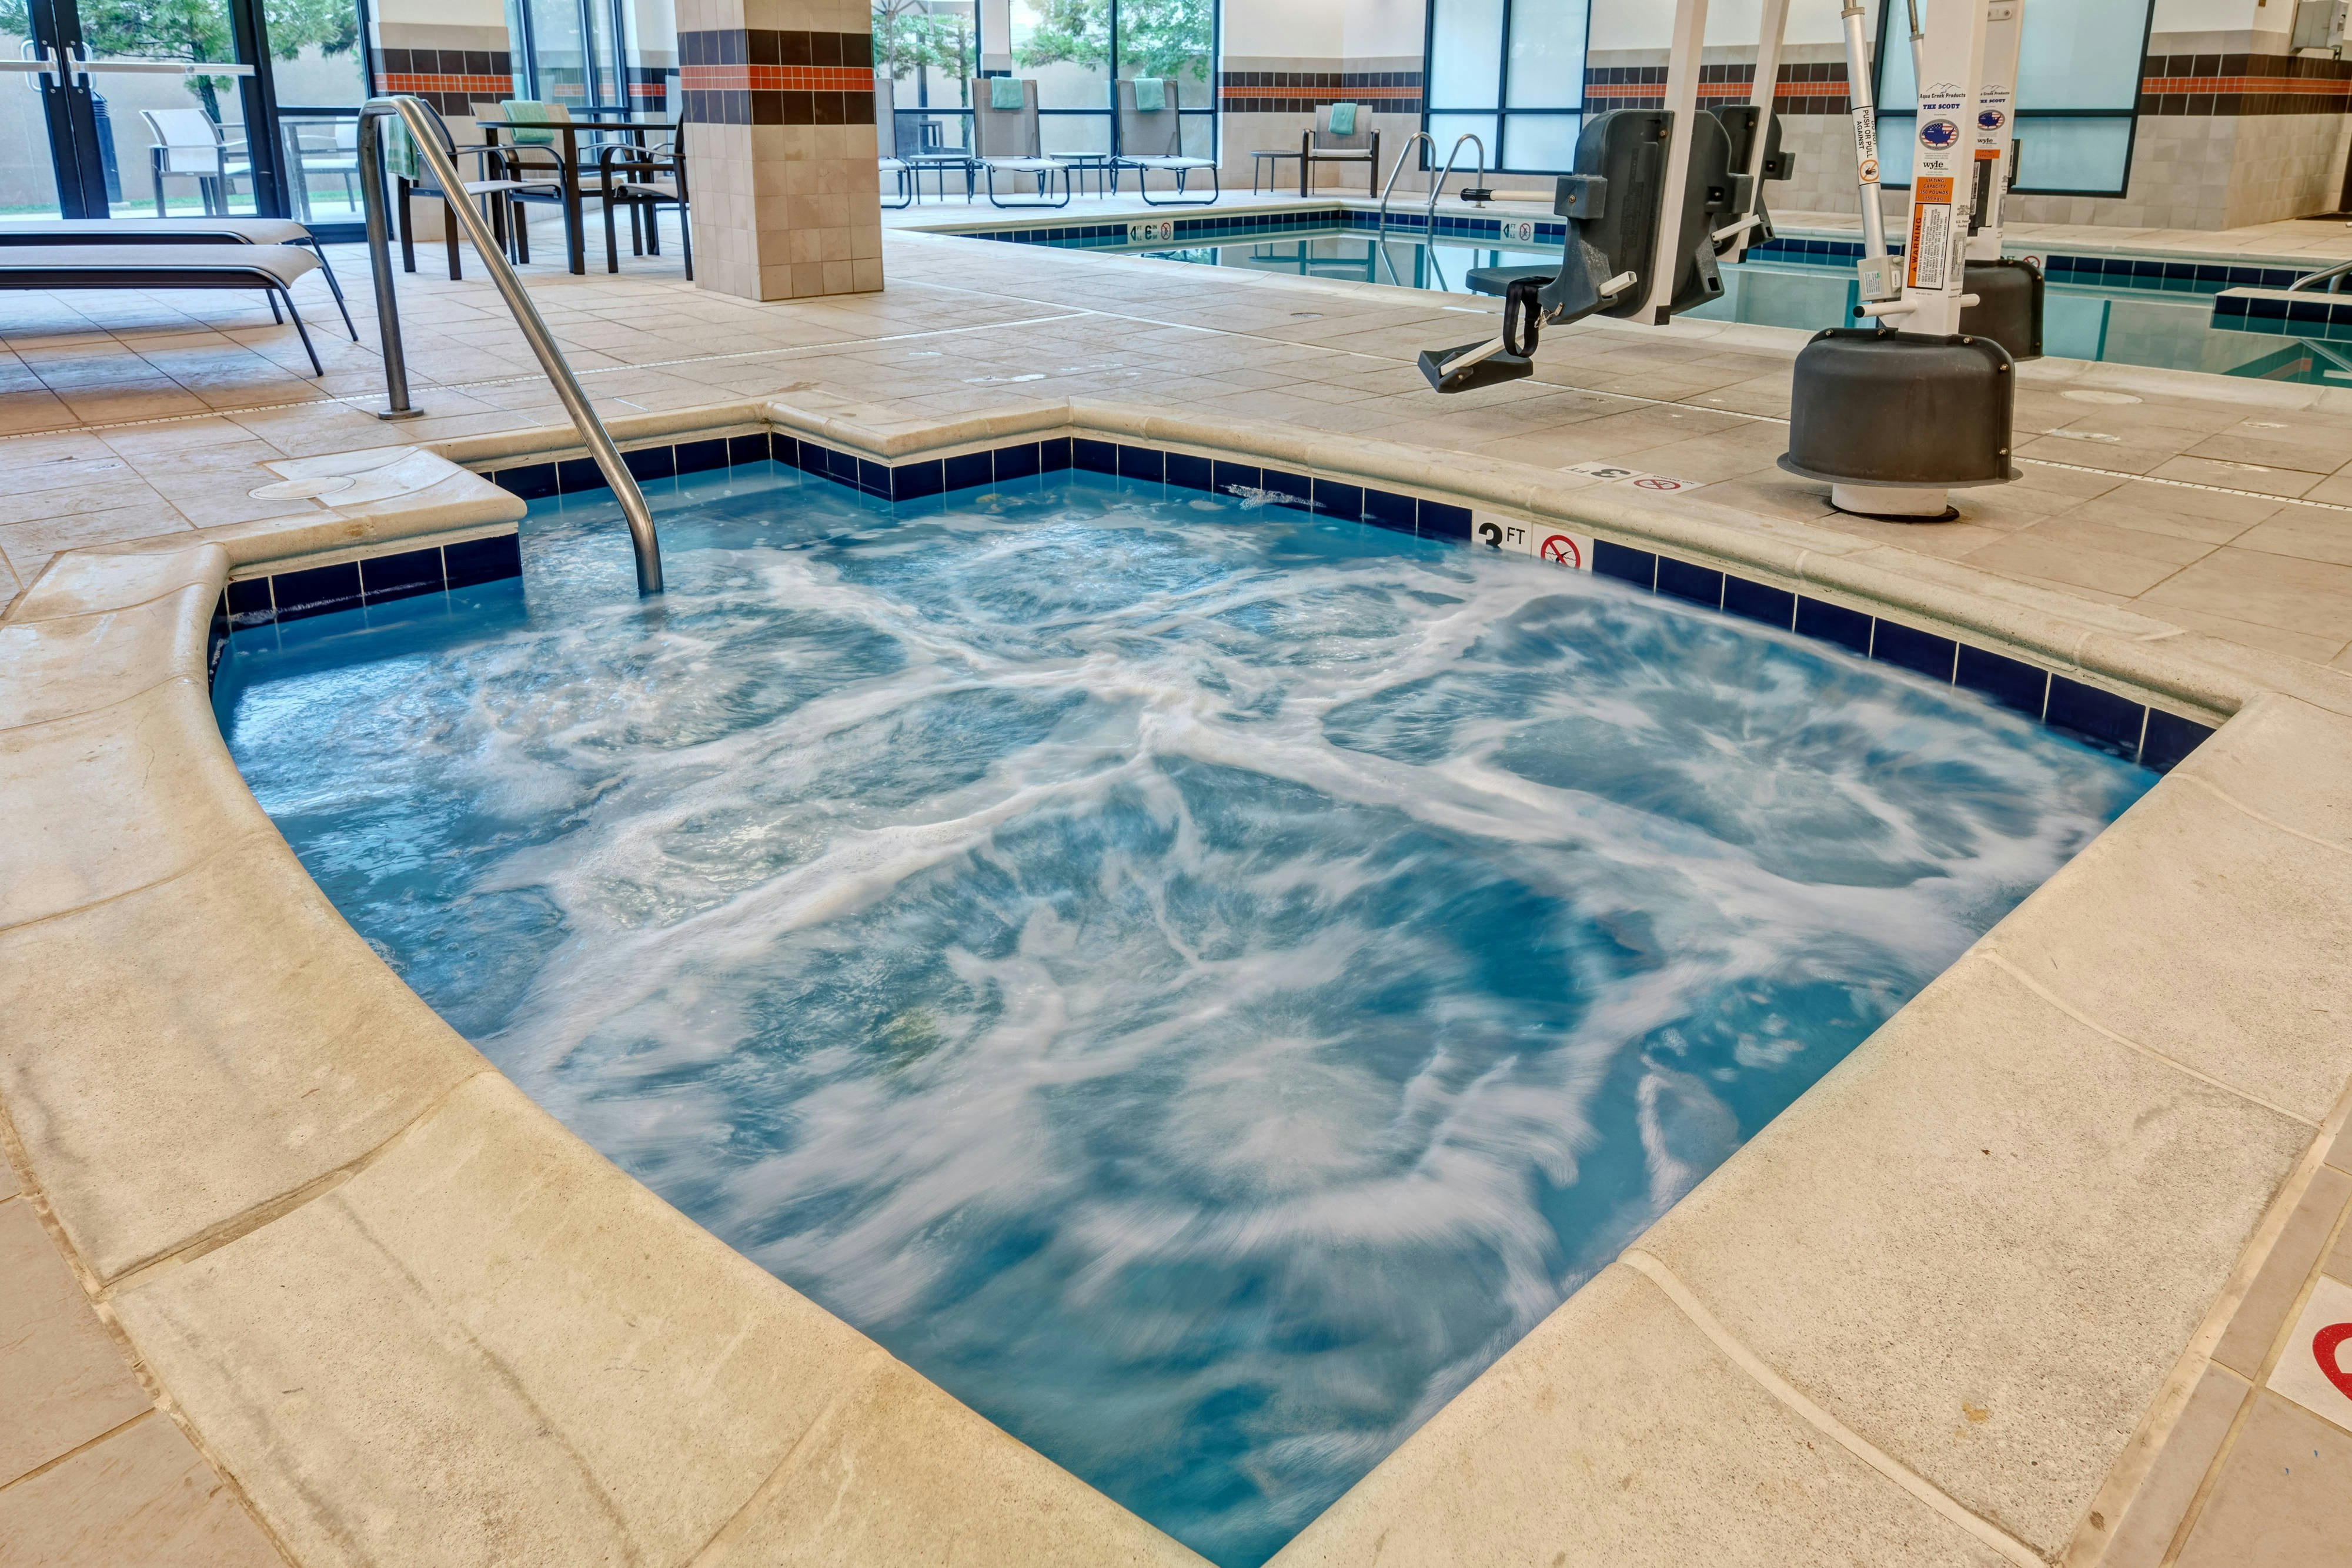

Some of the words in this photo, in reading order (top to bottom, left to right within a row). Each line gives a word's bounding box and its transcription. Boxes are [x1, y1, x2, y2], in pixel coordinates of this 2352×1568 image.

[1865, 129, 1871, 140] OR
[1923, 161, 1943, 169] wyle
[1912, 218, 1921, 263] WARNING
[1591, 469, 1631, 478] 3
[1478, 523, 1503, 549] 3
[1506, 526, 1525, 545] FT
